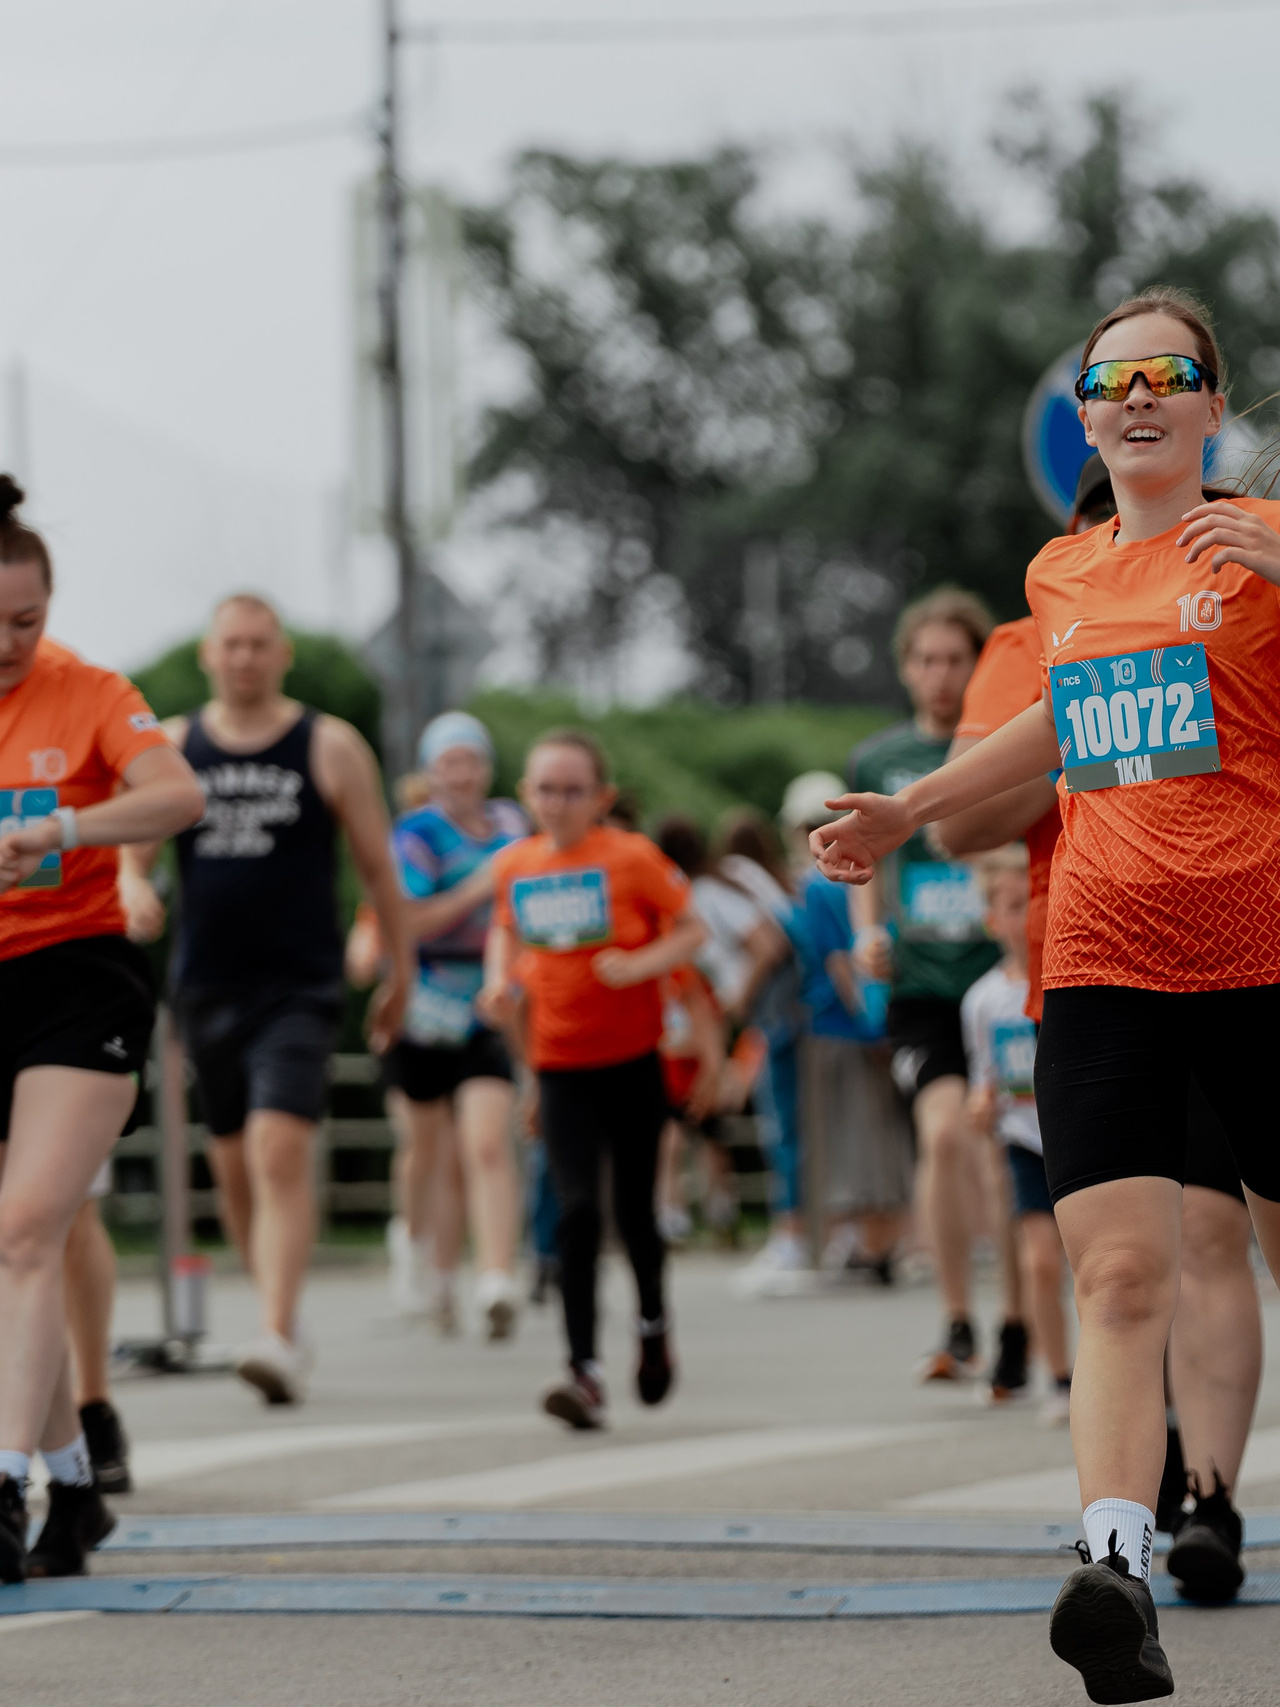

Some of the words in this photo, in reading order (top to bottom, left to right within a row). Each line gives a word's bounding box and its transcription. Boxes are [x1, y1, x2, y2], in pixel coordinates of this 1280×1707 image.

[1176, 590, 1222, 632] 10
[1063, 675, 1081, 687] ПСБ
[1109, 658, 1137, 687] 10
[1065, 682, 1200, 760] 10072
[1114, 754, 1154, 786] 1KM
